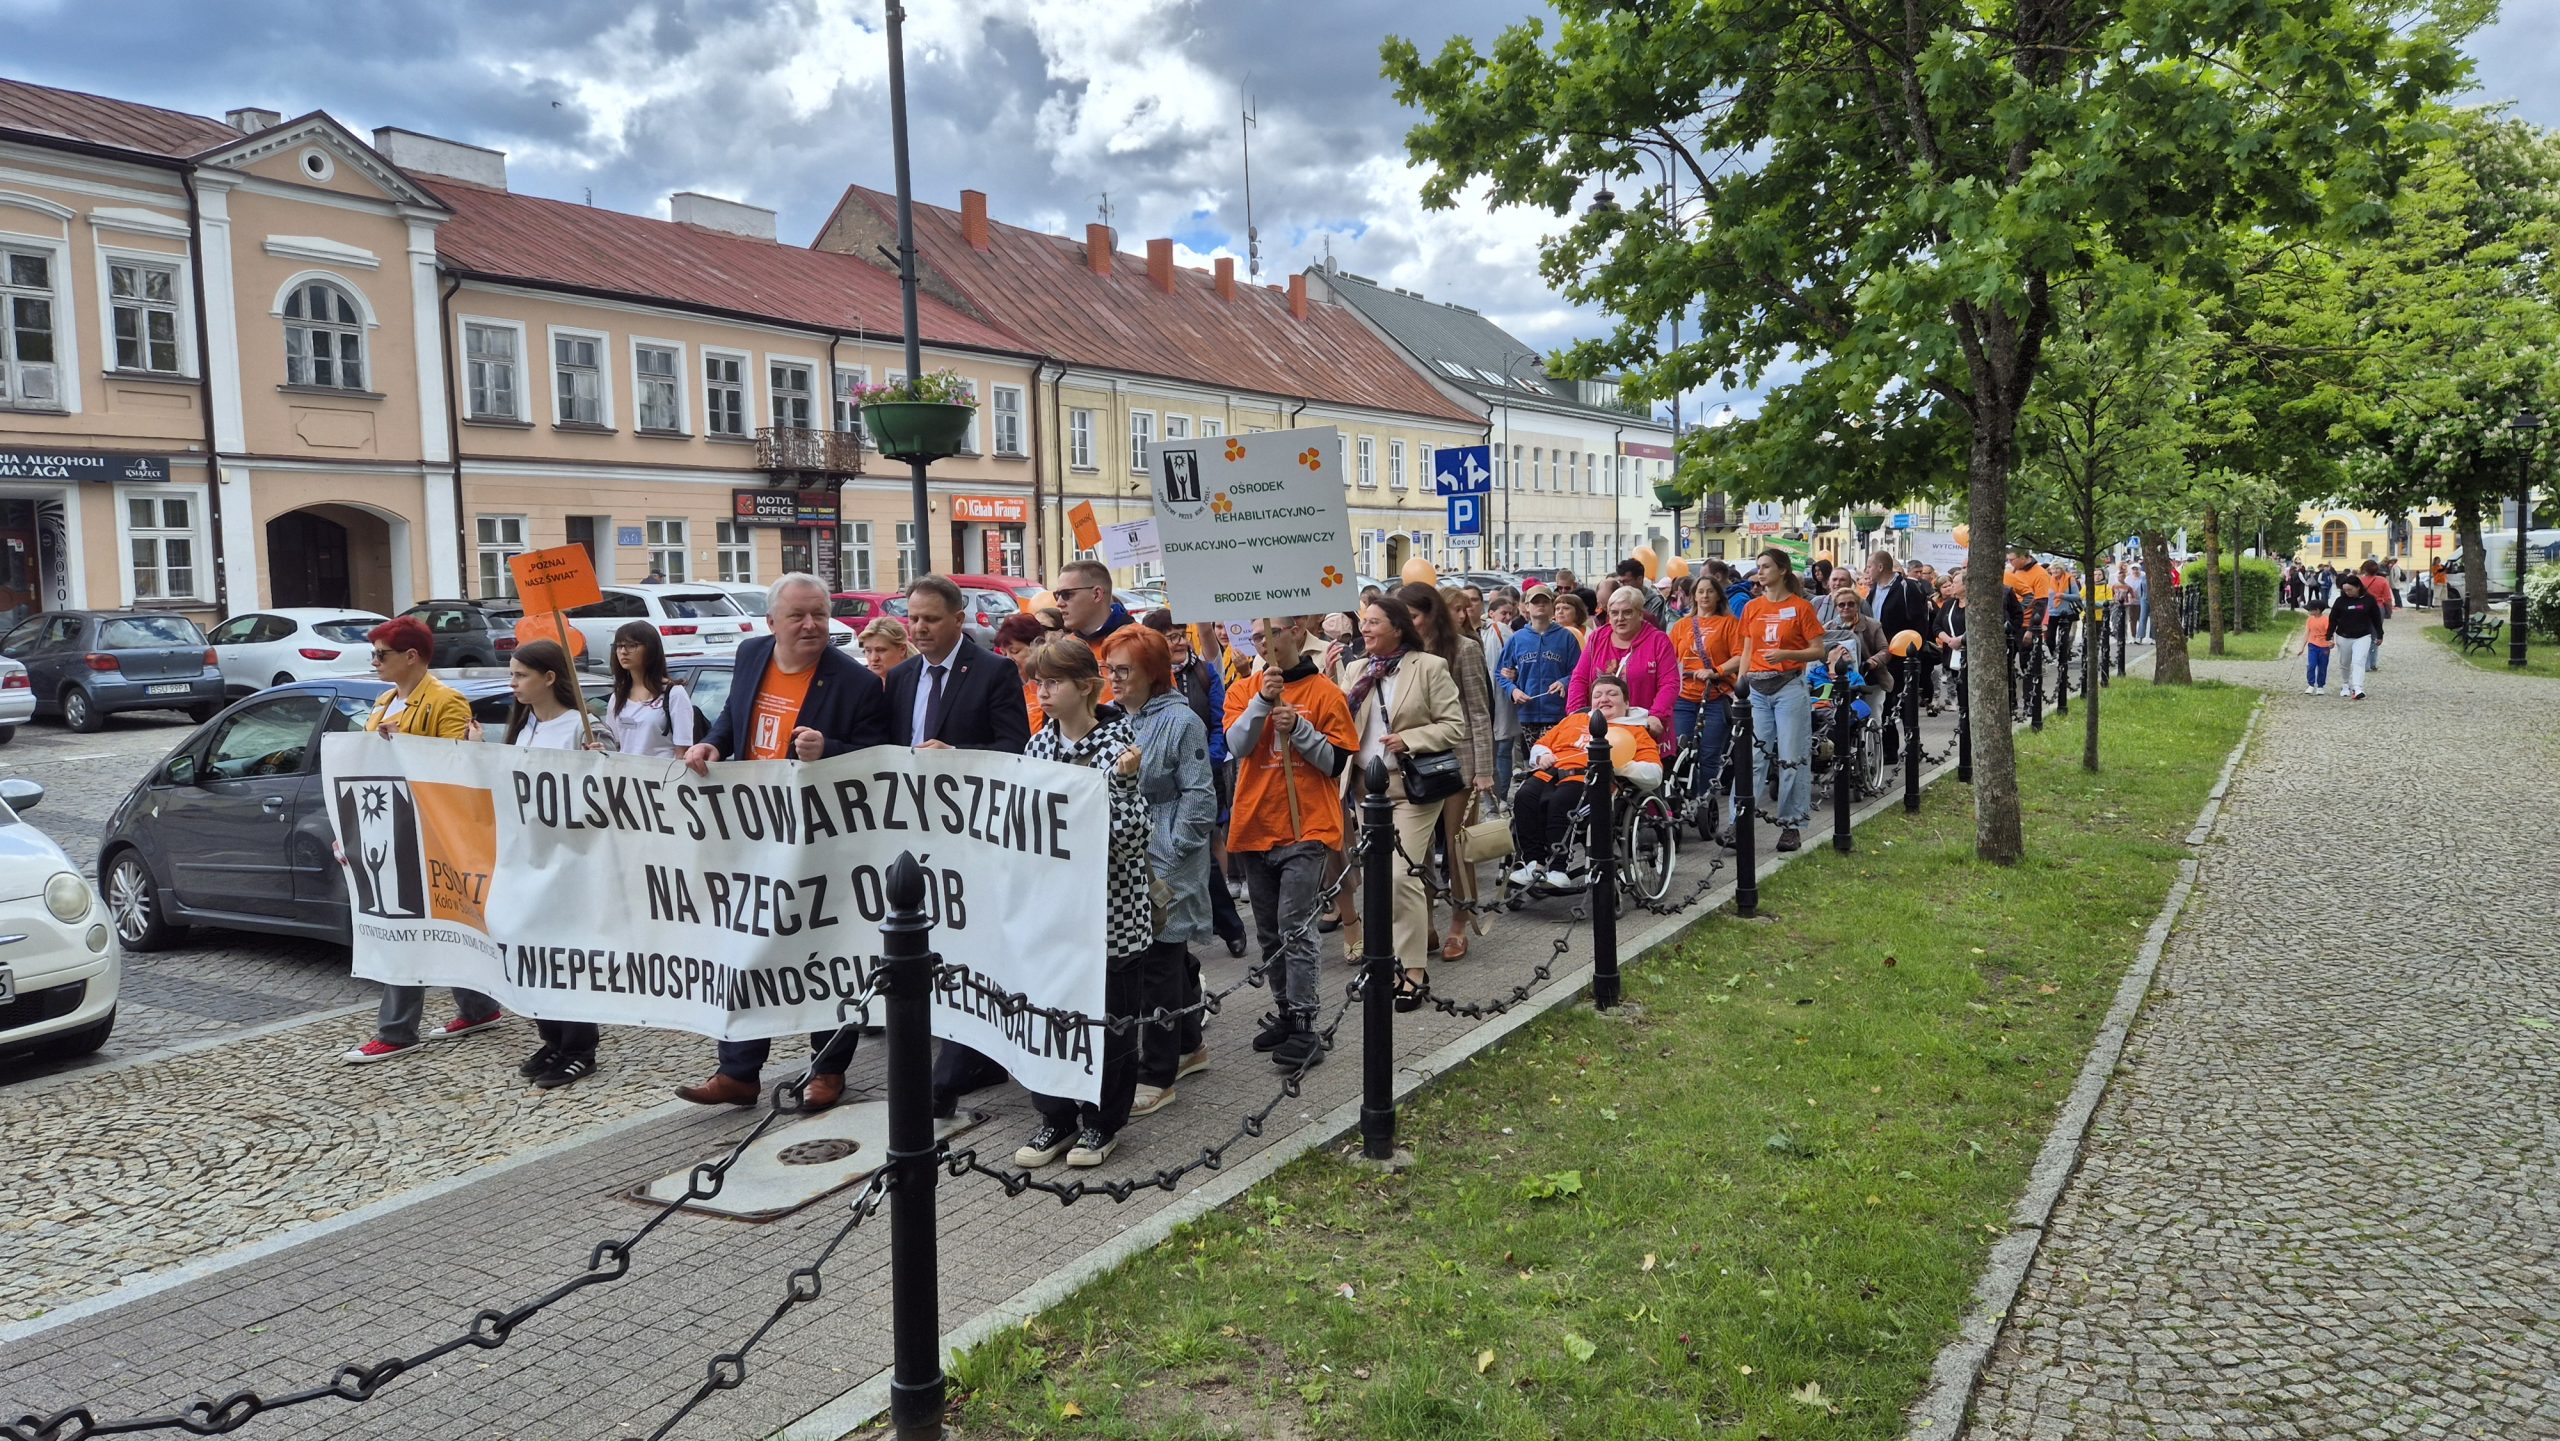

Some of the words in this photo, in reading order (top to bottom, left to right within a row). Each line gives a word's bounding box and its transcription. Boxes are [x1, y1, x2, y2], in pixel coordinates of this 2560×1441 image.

[26, 455, 104, 467] ALKOHOLI
[1230, 480, 1285, 495] OŚRODEK
[756, 495, 794, 505] MOTYL
[969, 499, 993, 516] Kebab
[756, 505, 794, 515] OFFICE
[1455, 500, 1472, 530] P
[1452, 537, 1476, 545] Koniec
[1252, 564, 1264, 574] W
[525, 577, 545, 587] NASZ
[1214, 591, 1262, 603] BRODZIE
[1267, 588, 1311, 600] NOWYM
[512, 770, 674, 835] POLSKIE
[677, 771, 1071, 860] STOWARZYSZENIE
[645, 864, 701, 925] NA
[704, 872, 839, 938] RZECZ
[851, 854, 967, 931] OÓB
[358, 923, 418, 942] OTWIERAMY
[422, 929, 461, 944] PRZED
[497, 942, 511, 984] Z
[517, 945, 881, 1012] NIEPEŁNOSPRAWNOŚCI
